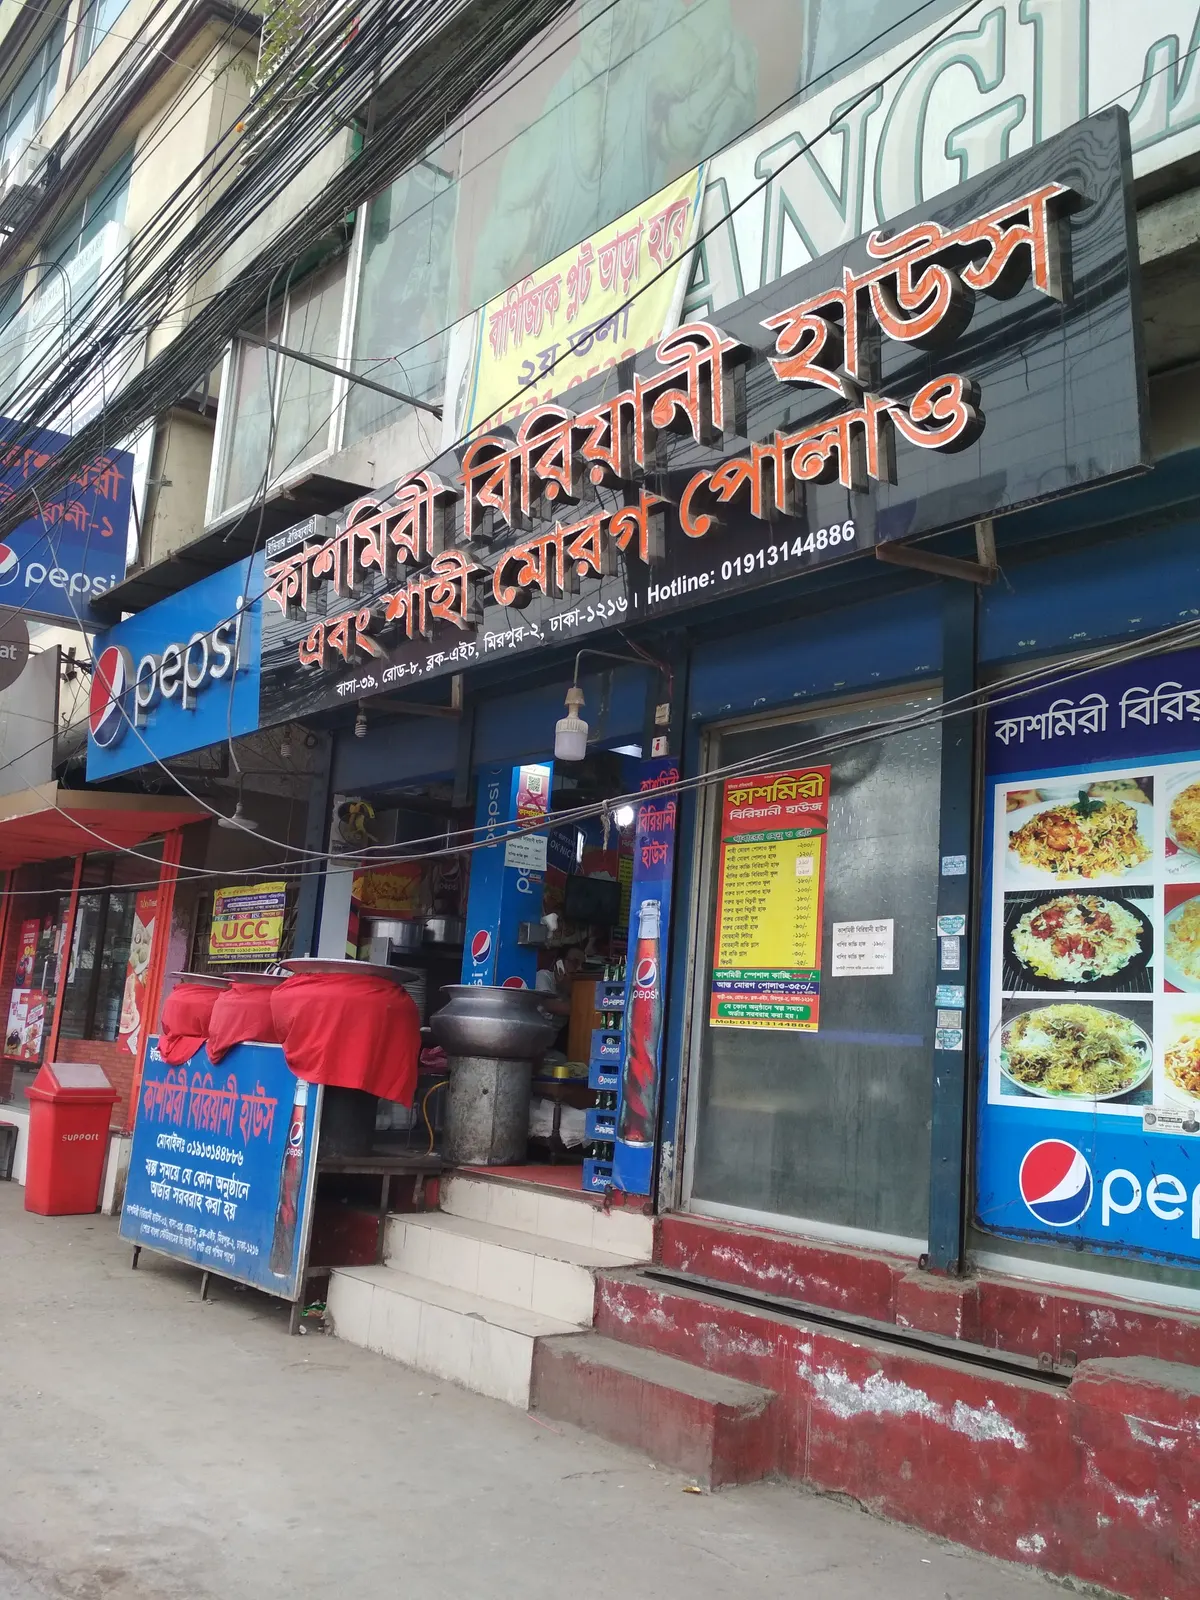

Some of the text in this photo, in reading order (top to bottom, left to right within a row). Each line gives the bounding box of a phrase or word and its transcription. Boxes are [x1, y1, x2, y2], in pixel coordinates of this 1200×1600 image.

[597, 217, 645, 296] ভাড়া
[648, 196, 691, 273] হবে
[566, 301, 636, 358] তলা
[264, 180, 1075, 618] কাশমিরী বিরিয়ানী হাউস
[298, 373, 970, 672] এবং শাহী মোরগ পোলাও
[381, 661, 424, 685] রোড-৮,
[482, 621, 545, 654] মিরপুর-২,
[548, 598, 629, 633] ঢাকা-১২১৬
[646, 564, 716, 606] Hotline:
[720, 519, 856, 582] 01913144886
[134, 595, 244, 728] pepsi
[994, 692, 1110, 746] কাশমিরী
[727, 772, 826, 806] কাশমিরী
[638, 801, 677, 832] বিরিয়ানী
[729, 804, 782, 820] বিরিয়ানী
[641, 839, 669, 869] হাউস
[221, 919, 270, 941] UCC
[715, 970, 742, 979] কাশমিরী
[632, 986, 659, 1002] pepsi
[143, 1068, 278, 1148] কাশমিরী বিরিয়ানী হাউস
[186, 1140, 244, 1167] ০১৯১৩১৪৪৮৮৬
[181, 1168, 193, 1186] যে
[193, 1170, 215, 1191] কোন
[172, 1186, 204, 1214] সরবরাহ
[205, 1195, 222, 1217] করা
